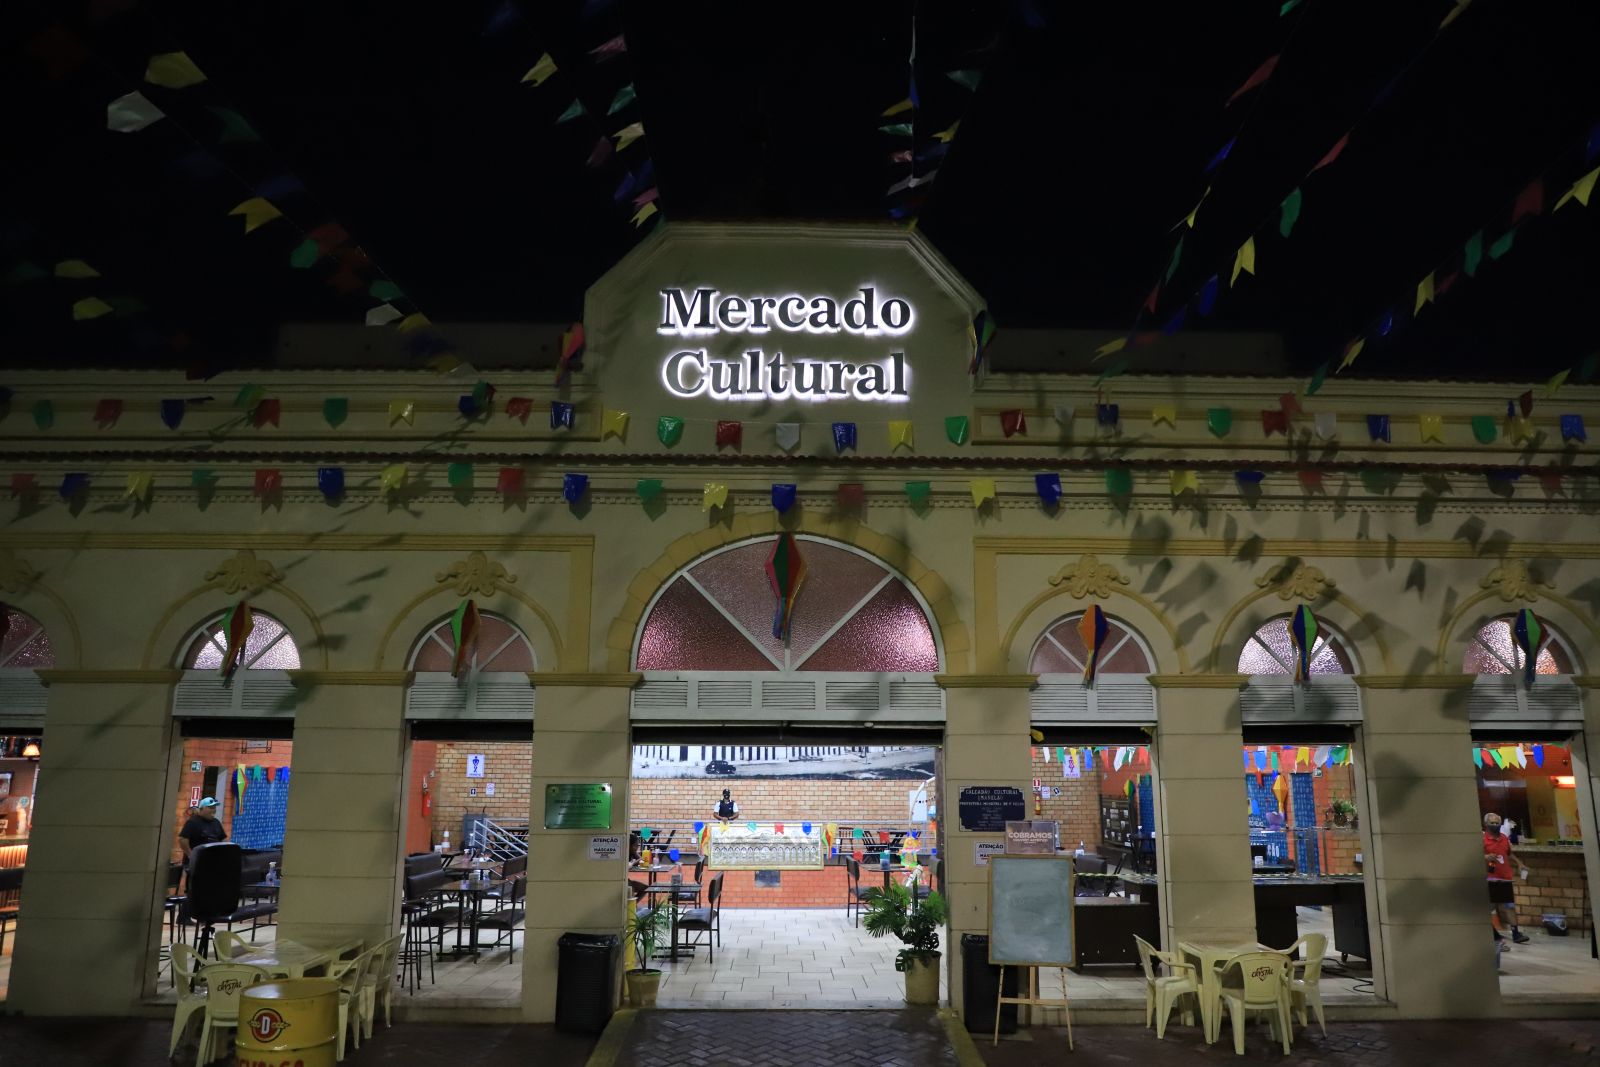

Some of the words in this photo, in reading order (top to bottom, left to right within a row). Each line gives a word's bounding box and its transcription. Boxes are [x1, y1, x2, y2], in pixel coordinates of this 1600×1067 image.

[659, 286, 912, 331] Mercado
[664, 350, 909, 397] Cultural
[1251, 968, 1274, 978] CRYSTAL
[217, 981, 242, 992] CRYSTAL
[261, 1015, 271, 1035] D
